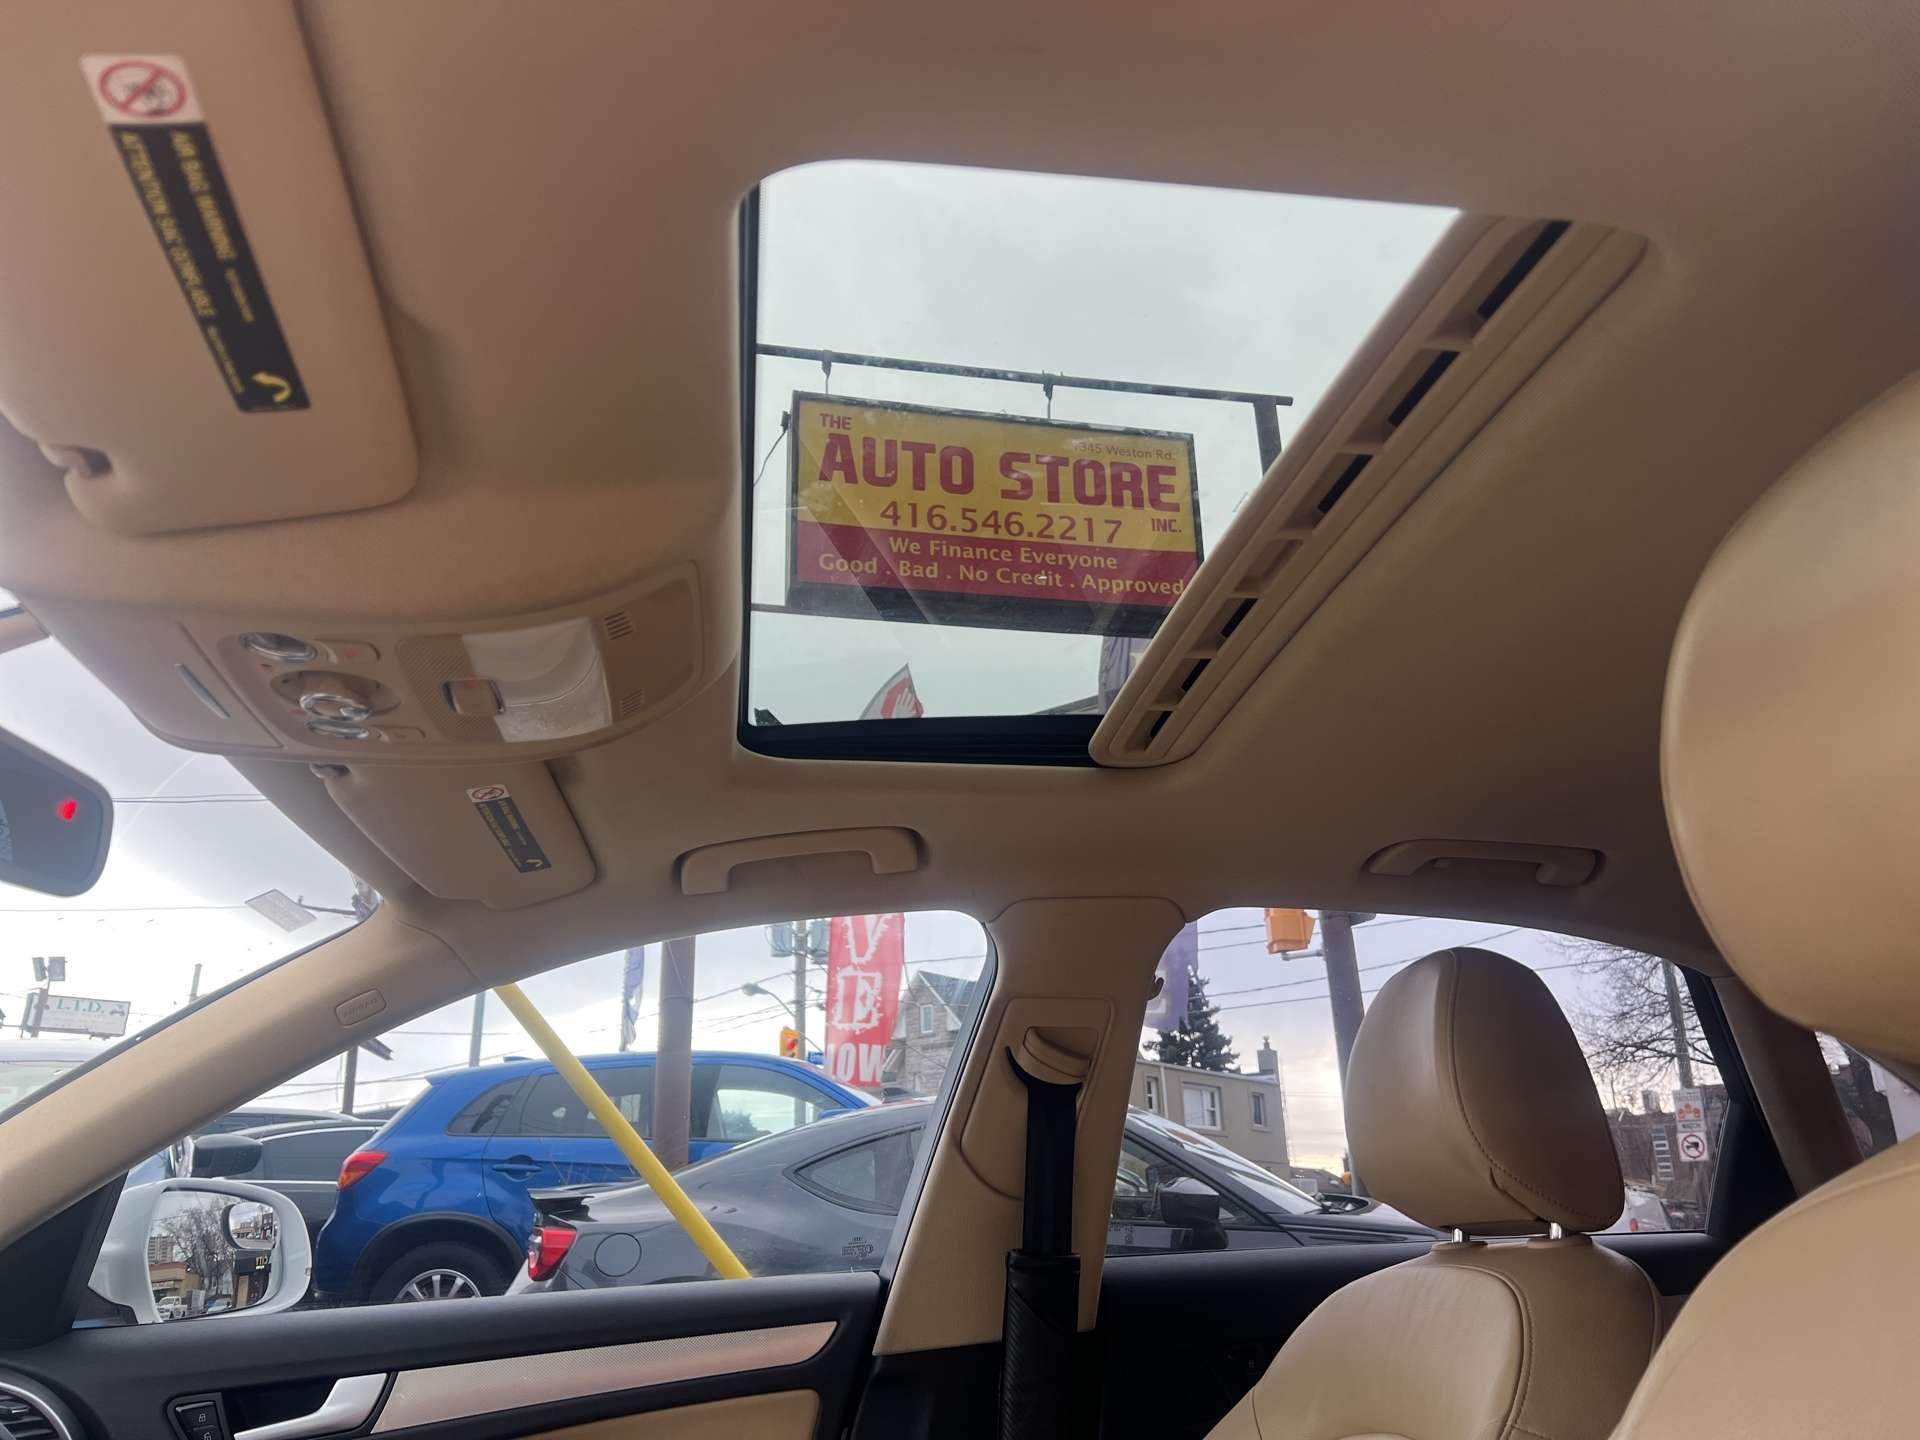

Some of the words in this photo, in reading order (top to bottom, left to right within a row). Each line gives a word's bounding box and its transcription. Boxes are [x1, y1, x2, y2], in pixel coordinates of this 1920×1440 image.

[820, 413, 852, 430] THE
[1105, 444, 1152, 459] Weston
[818, 433, 975, 496] AUTO
[1000, 451, 1181, 513] STORE
[880, 500, 1122, 544] 416.546.2217
[1151, 518, 1182, 533] INC.
[889, 537, 921, 555] We
[930, 540, 1013, 562] Finance
[1020, 547, 1118, 570] Everyone
[819, 553, 877, 575] Good
[899, 560, 938, 579] Bad
[959, 564, 989, 582] No
[996, 567, 1063, 588] Credit
[1081, 573, 1184, 596] Approved
